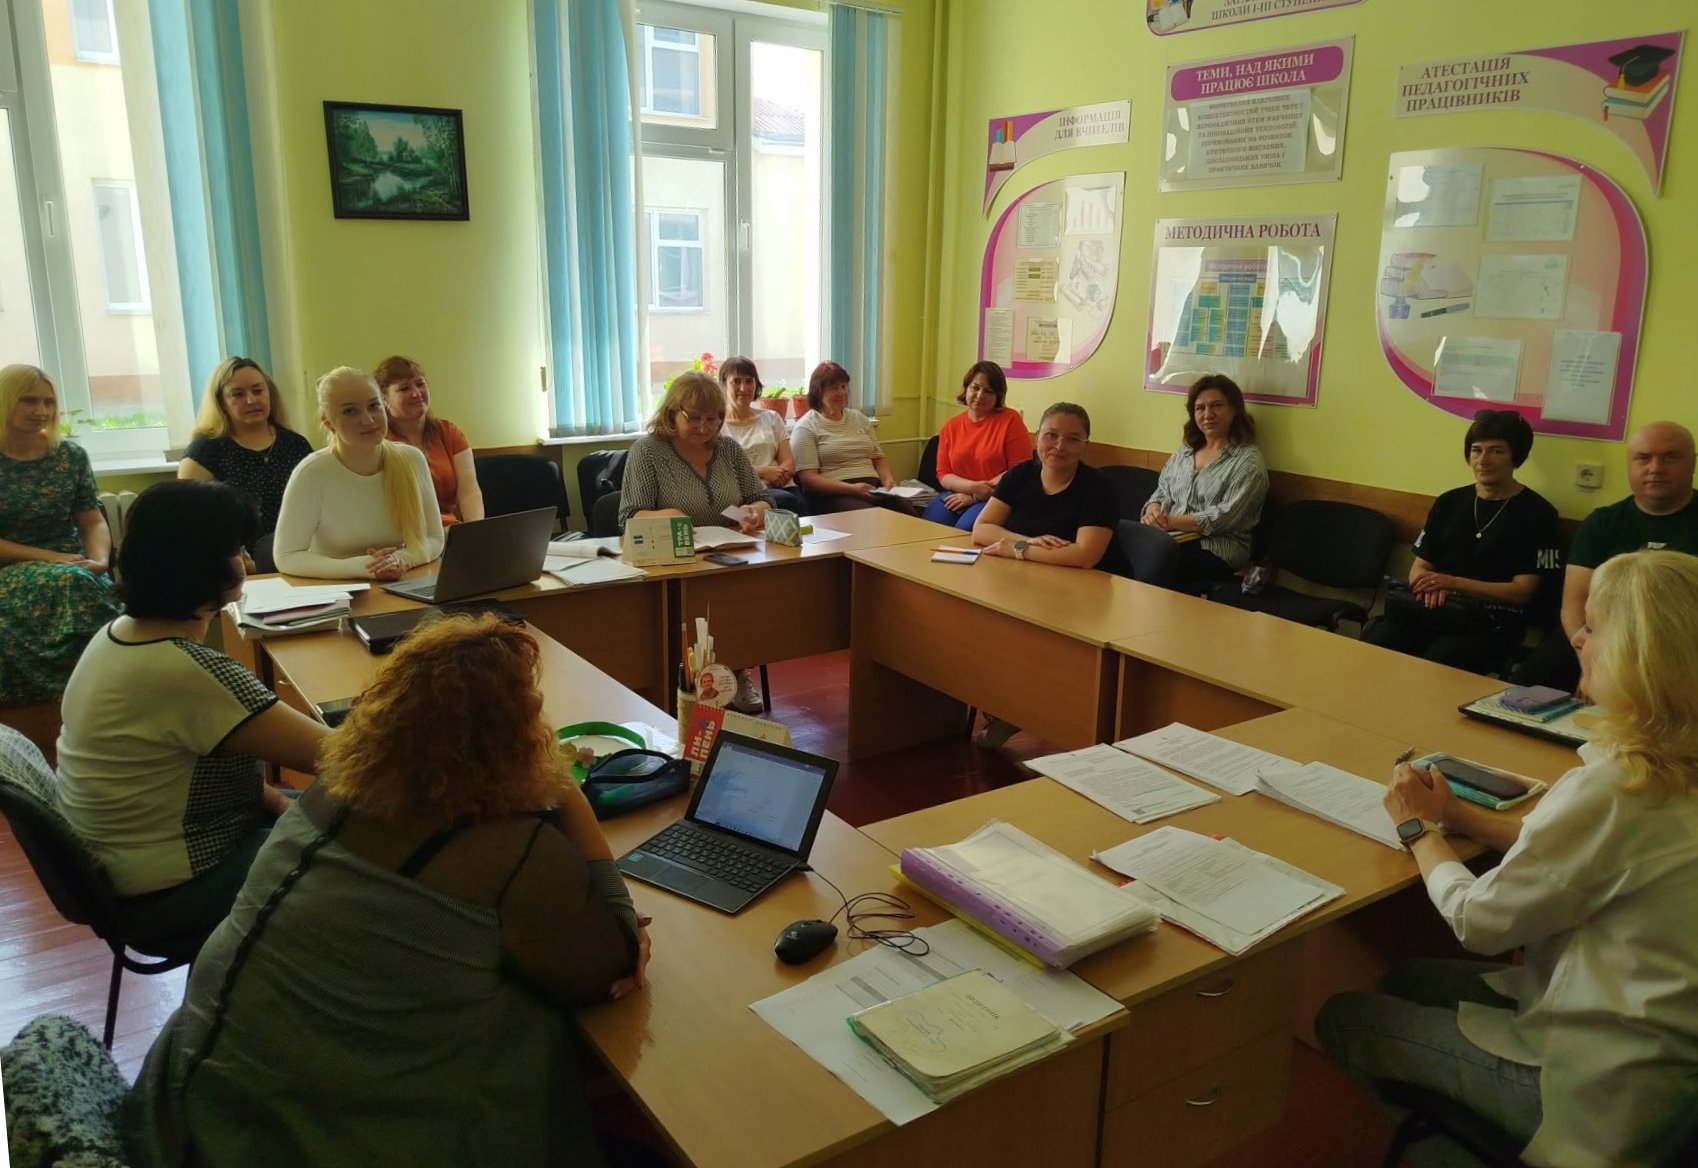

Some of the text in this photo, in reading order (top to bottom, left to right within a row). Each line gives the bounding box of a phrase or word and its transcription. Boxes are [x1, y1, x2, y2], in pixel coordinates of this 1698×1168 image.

[1236, 62, 1261, 76] НАД
[1264, 53, 1315, 71] ЯКИМИ
[1421, 57, 1511, 79] АТЕСТАЦІЯ
[1200, 70, 1307, 94] ПРАЦЮЄ ШКОЛА
[1402, 71, 1530, 97] ПЕДАГОГІЧНИХ
[1406, 89, 1520, 112] ПРАЦІВНИКІВ
[1054, 127, 1074, 140] ДЛЯ
[1165, 223, 1321, 240] МЕТОДИЧНА РОБОТА
[700, 720, 715, 758] ПЕНЬ
